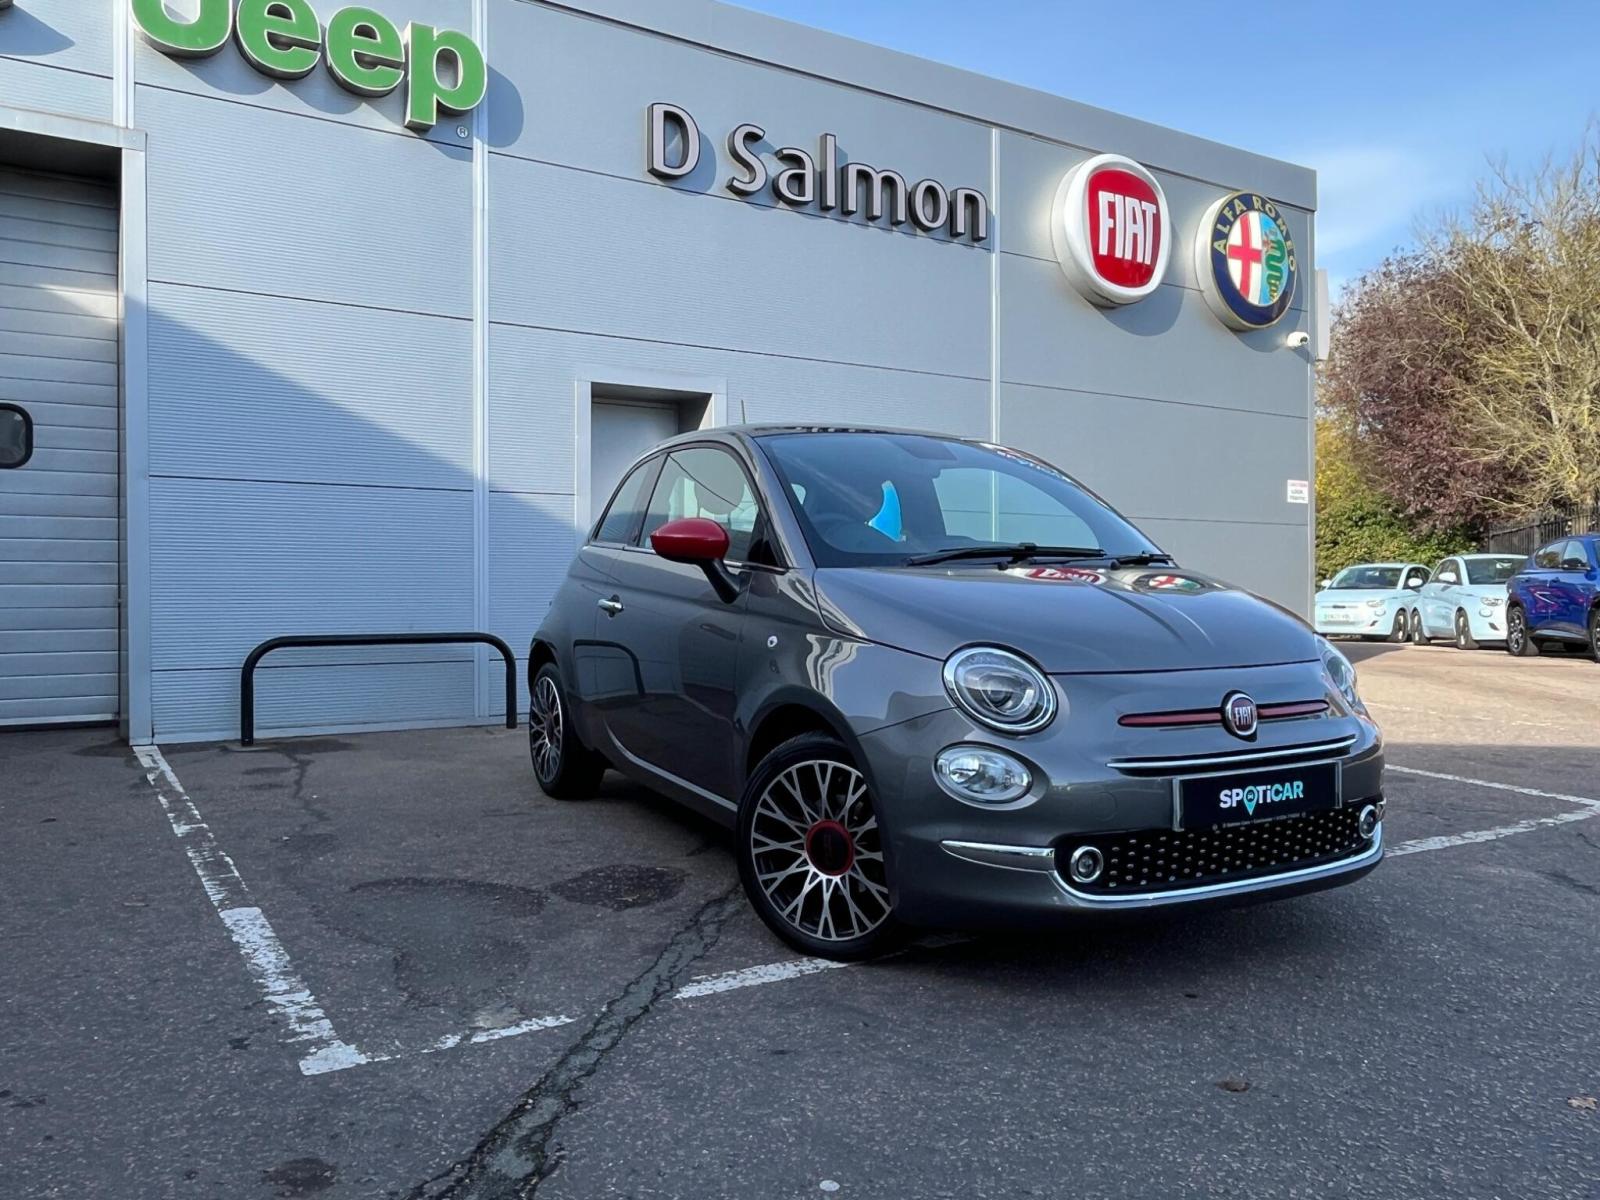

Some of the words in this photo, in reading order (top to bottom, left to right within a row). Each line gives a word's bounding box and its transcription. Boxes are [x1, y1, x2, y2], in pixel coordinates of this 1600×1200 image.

[647, 102, 700, 179] D
[726, 123, 988, 242] Salmon
[1097, 190, 1157, 265] FIAT
[1213, 199, 1246, 256] ALFA
[1252, 195, 1297, 273] ROMEO
[1234, 706, 1253, 726] FIAT
